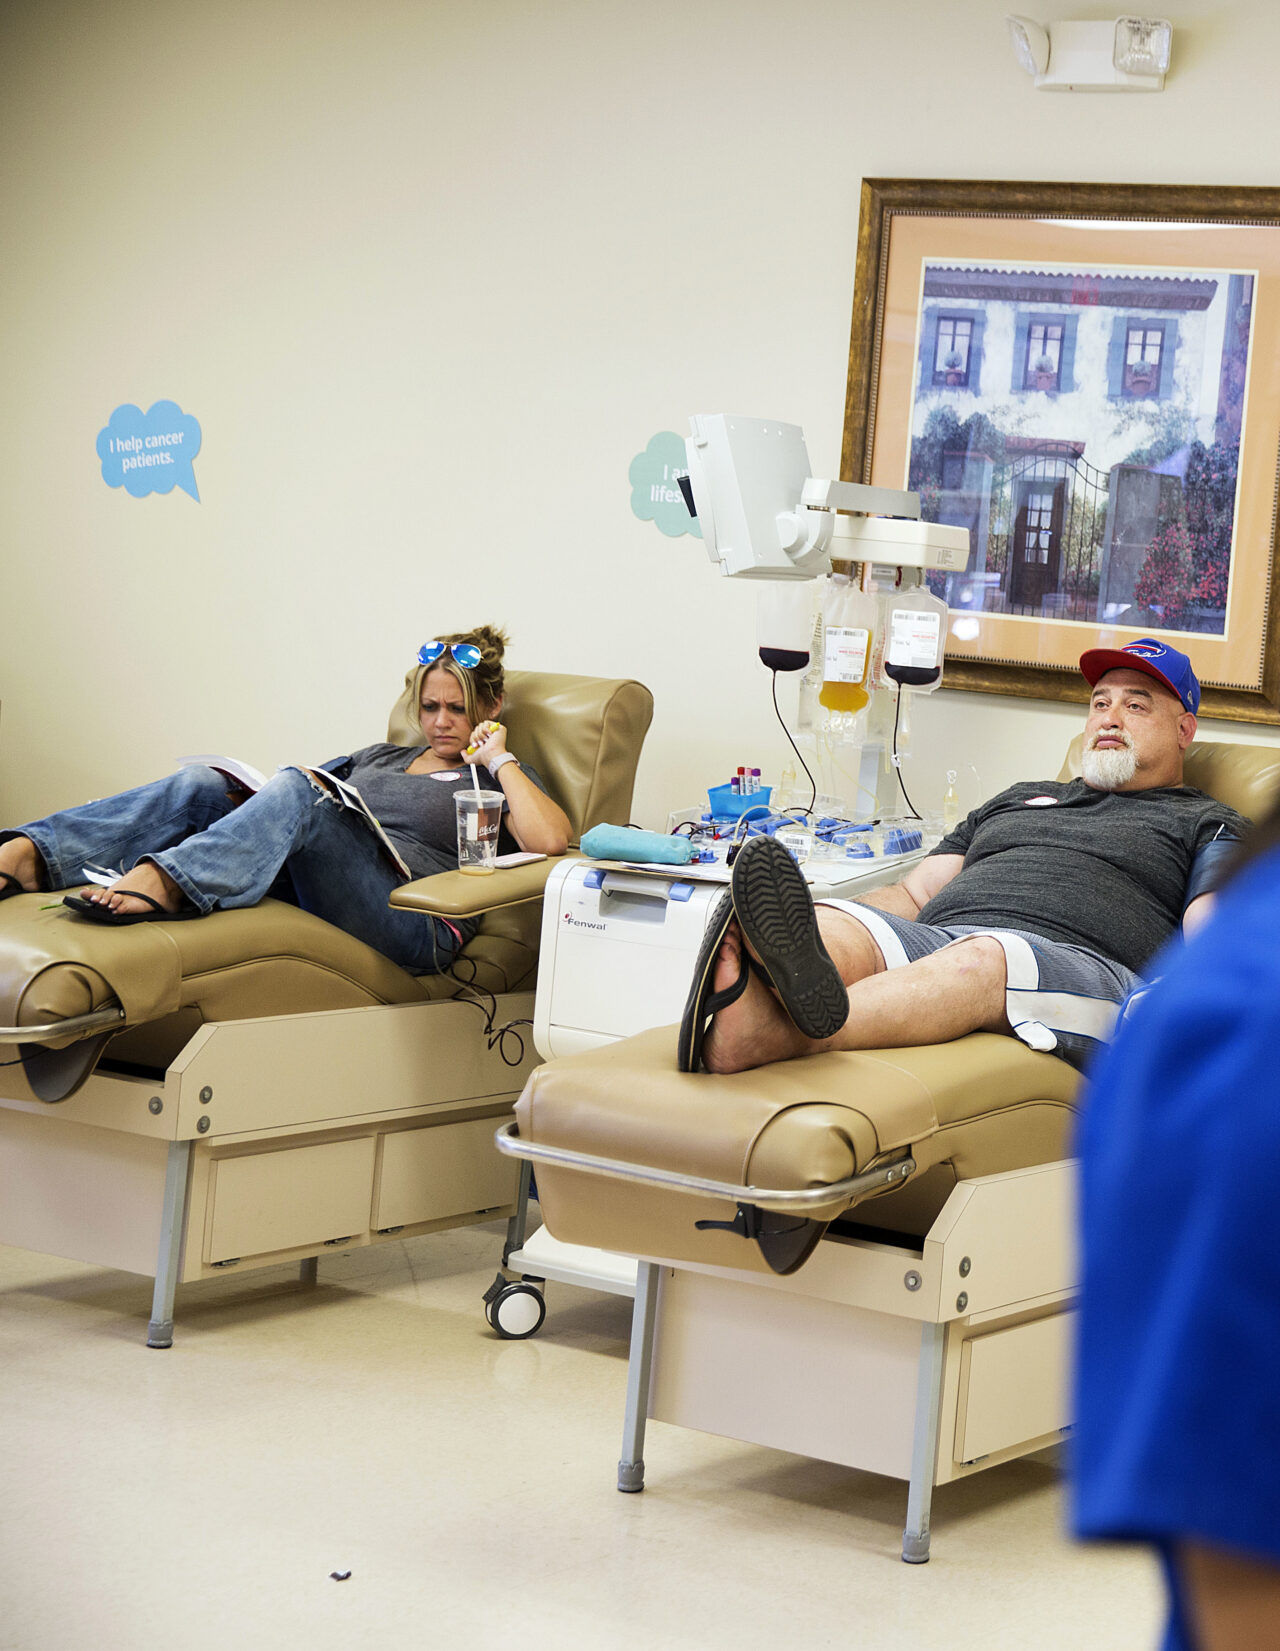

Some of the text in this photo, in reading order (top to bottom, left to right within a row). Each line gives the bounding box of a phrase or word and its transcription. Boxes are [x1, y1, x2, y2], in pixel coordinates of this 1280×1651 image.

[116, 436, 143, 453] help
[145, 431, 184, 448] cancer
[122, 451, 175, 474] patients.
[663, 464, 668, 480] I
[567, 918, 607, 931] Fenwal
